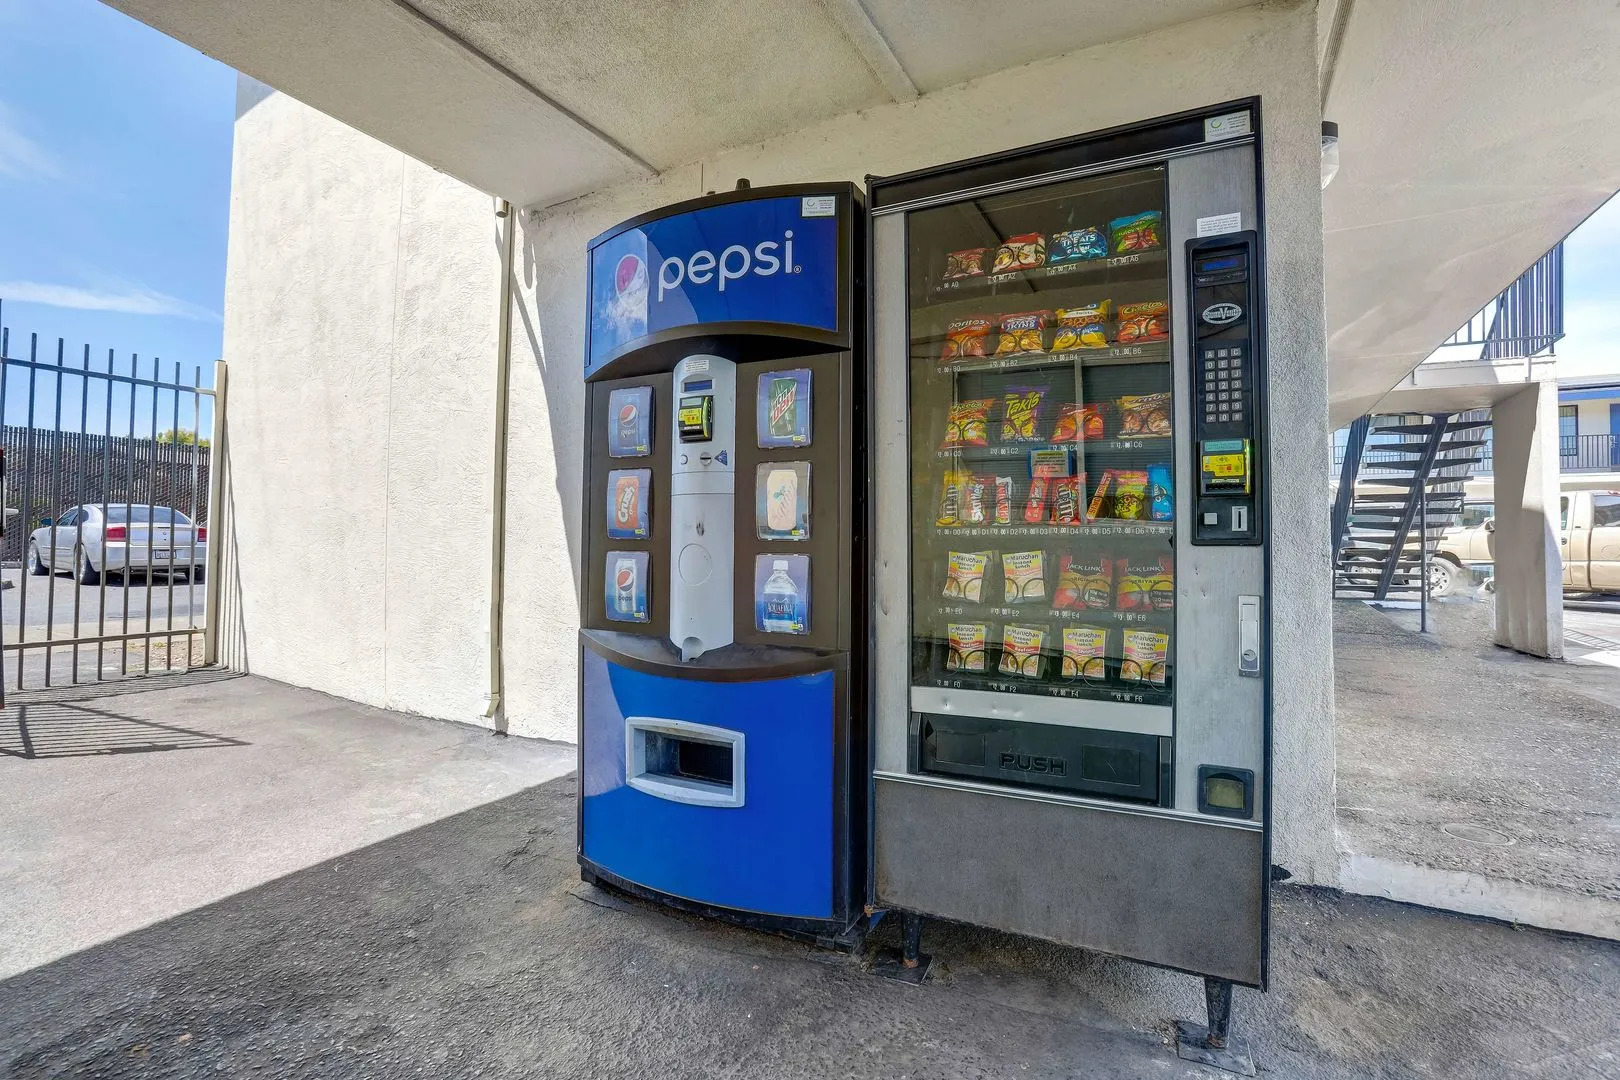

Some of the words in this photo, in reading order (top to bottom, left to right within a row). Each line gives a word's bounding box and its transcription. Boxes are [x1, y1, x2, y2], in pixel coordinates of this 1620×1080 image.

[1062, 235, 1096, 247] TREATS
[658, 230, 793, 302] pepsi
[1122, 302, 1165, 314] Cheetos
[948, 320, 985, 329] Doritos
[1006, 394, 1040, 418] Takis
[1154, 484, 1162, 502] OREO
[971, 483, 984, 522] Skittles
[956, 555, 982, 564] Maruchan
[1011, 629, 1040, 638] Maruchan
[1134, 635, 1164, 644] Maruchan
[1000, 752, 1066, 776] PUSH
